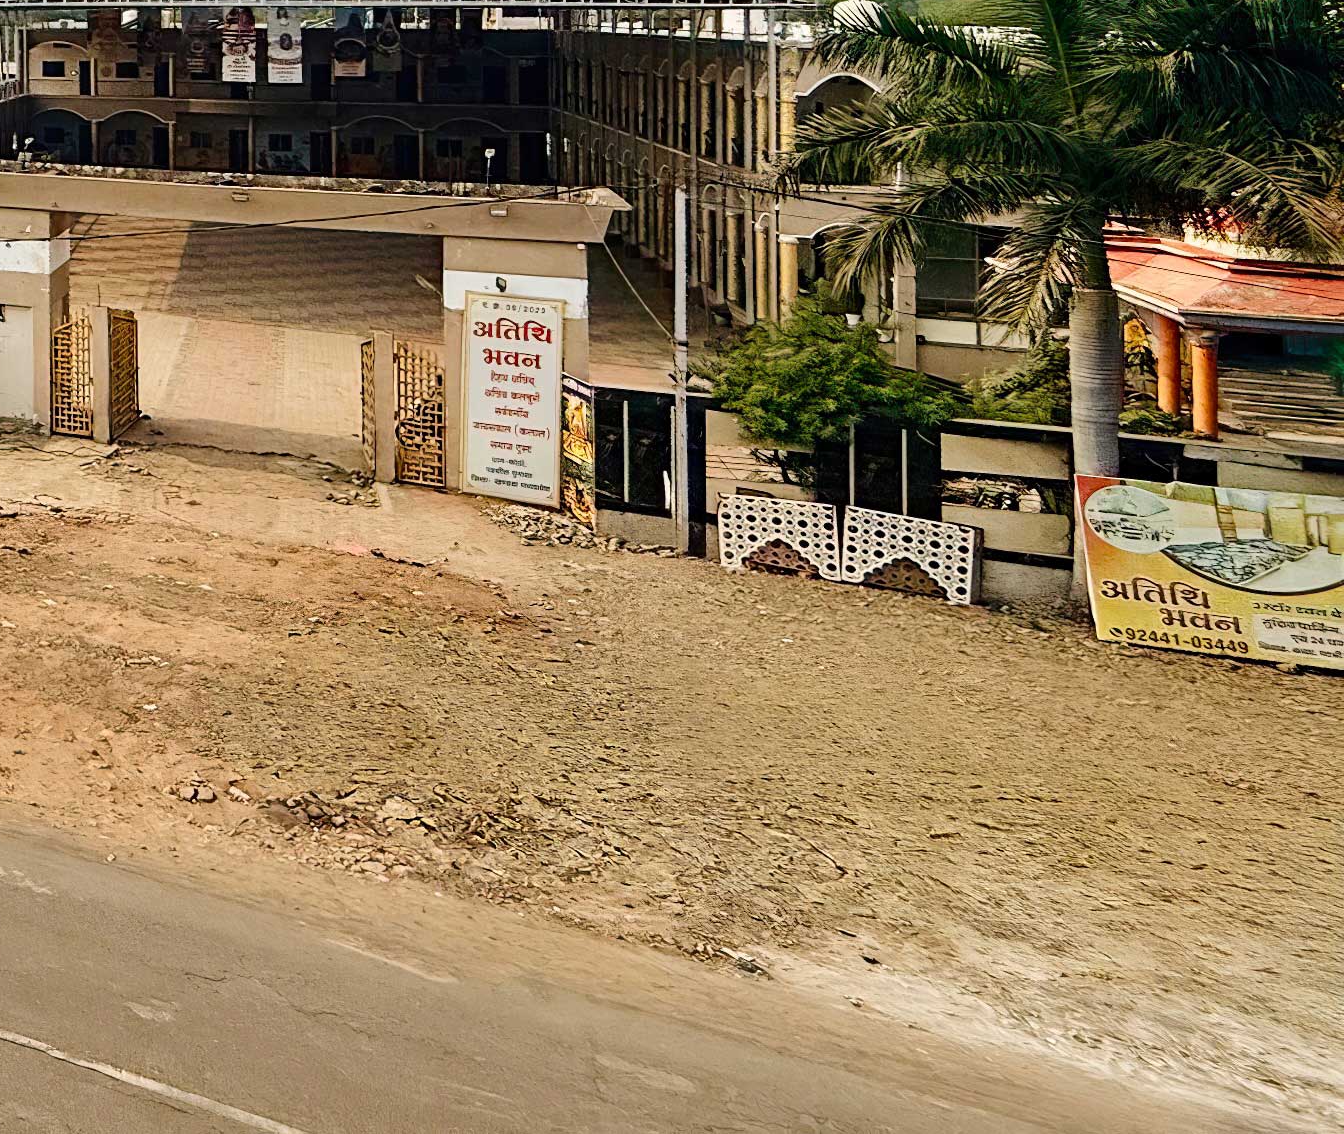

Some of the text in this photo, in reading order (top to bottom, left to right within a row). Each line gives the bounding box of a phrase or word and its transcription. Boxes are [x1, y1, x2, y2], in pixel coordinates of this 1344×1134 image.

[473, 317, 552, 344] अतिथि
[483, 348, 542, 370] भवन
[1101, 577, 1211, 609] अतिथि
[1159, 608, 1243, 634] भवन
[1127, 627, 1249, 654] 92441-03449
